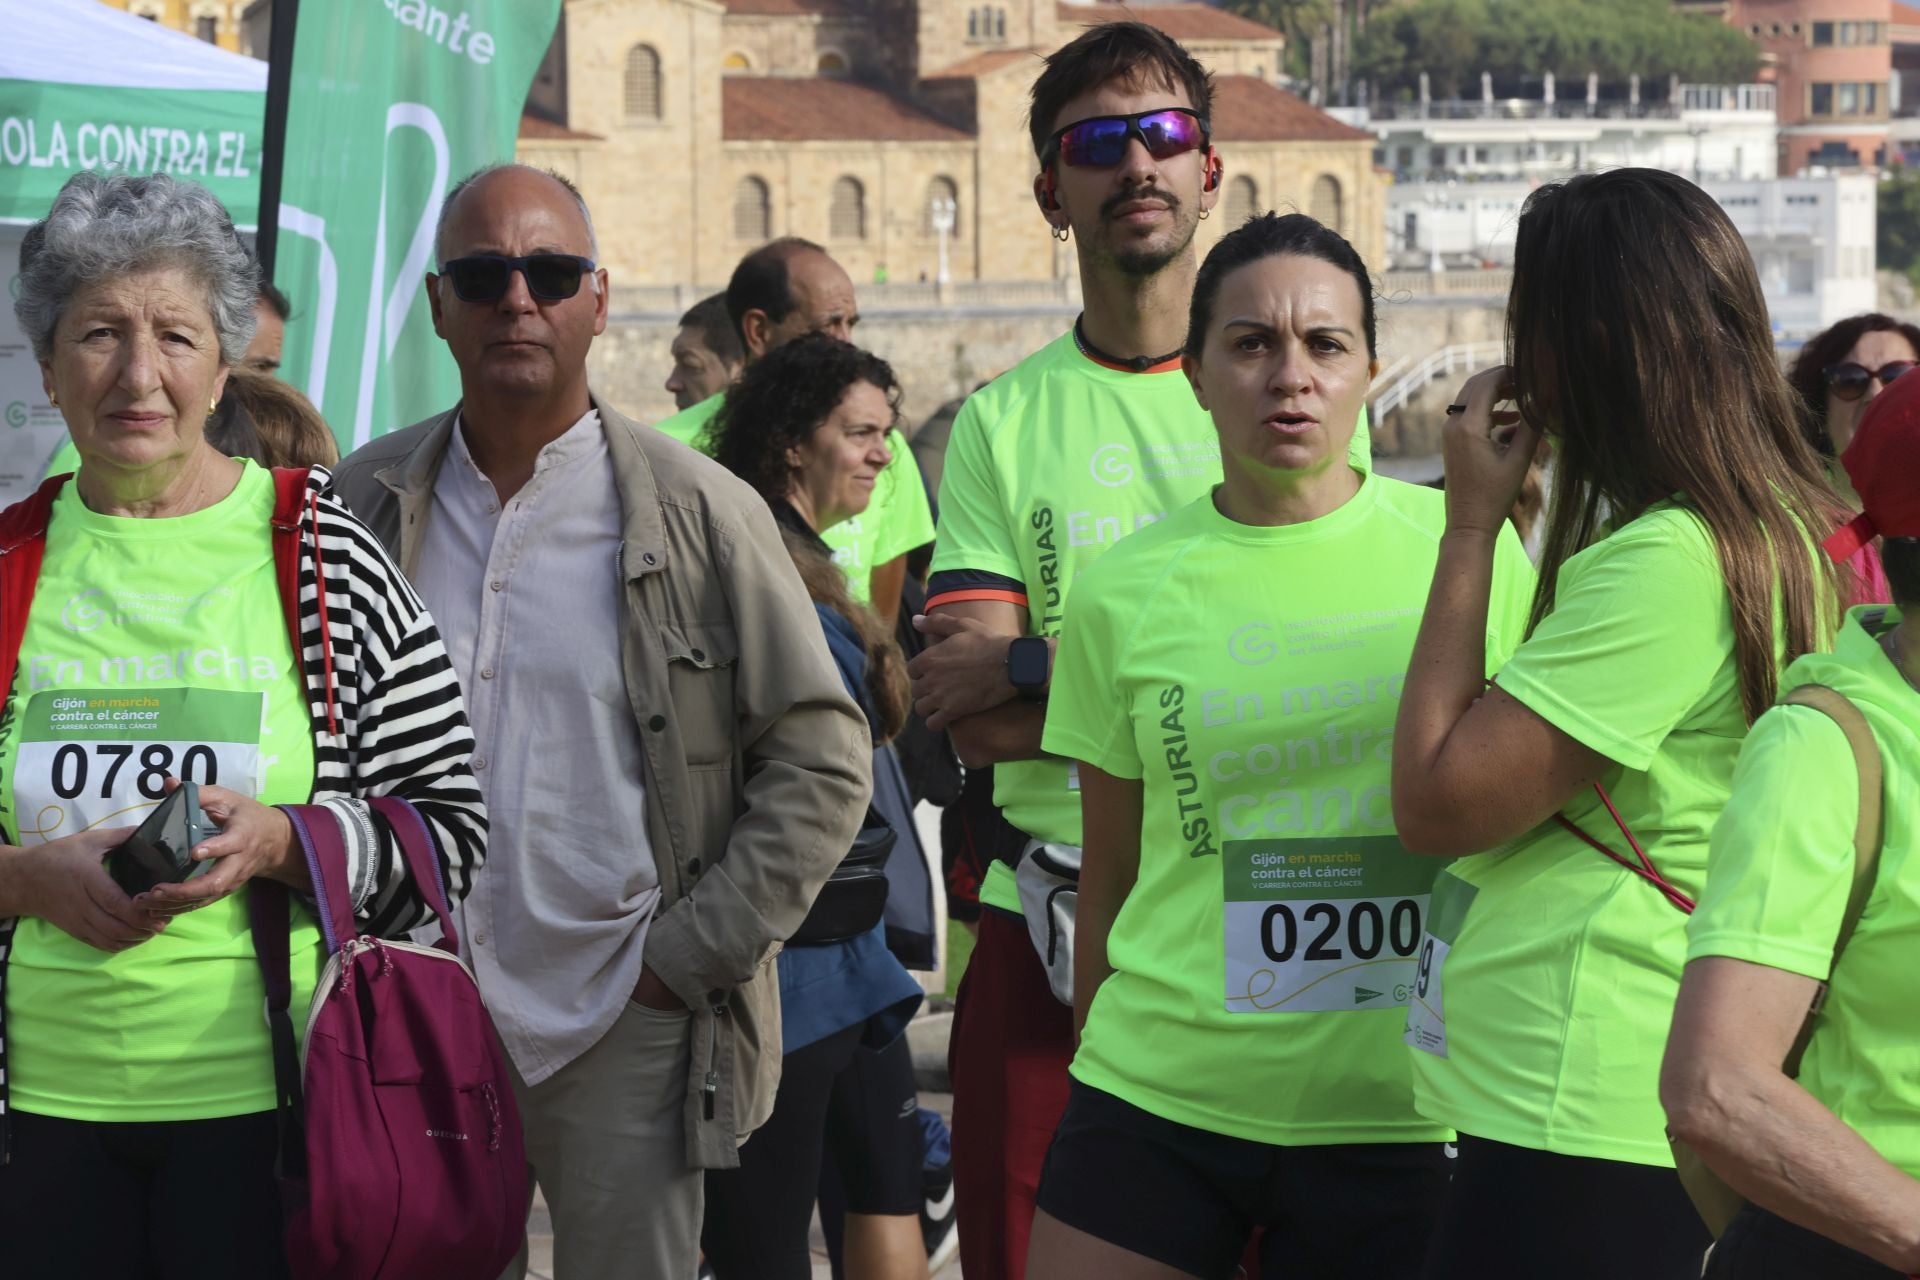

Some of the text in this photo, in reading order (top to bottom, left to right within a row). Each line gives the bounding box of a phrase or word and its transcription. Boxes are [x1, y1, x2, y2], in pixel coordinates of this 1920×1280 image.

[77, 122, 208, 176] CONTRA
[214, 131, 250, 177] EL
[30, 644, 279, 691] En marcha
[50, 709, 160, 721] contra el cáncer
[52, 696, 160, 711] Gijón en marcha
[1201, 687, 1265, 729] En
[50, 744, 219, 801] 0780
[1160, 683, 1219, 860] ASTURIAS
[1250, 851, 1362, 868] Gijón en marcha
[1250, 864, 1364, 880] contra el cáncer
[1258, 881, 1292, 889] CARRERA
[1292, 880, 1322, 888] CONTRA
[1323, 880, 1333, 888] EL
[1260, 898, 1422, 963] 0200
